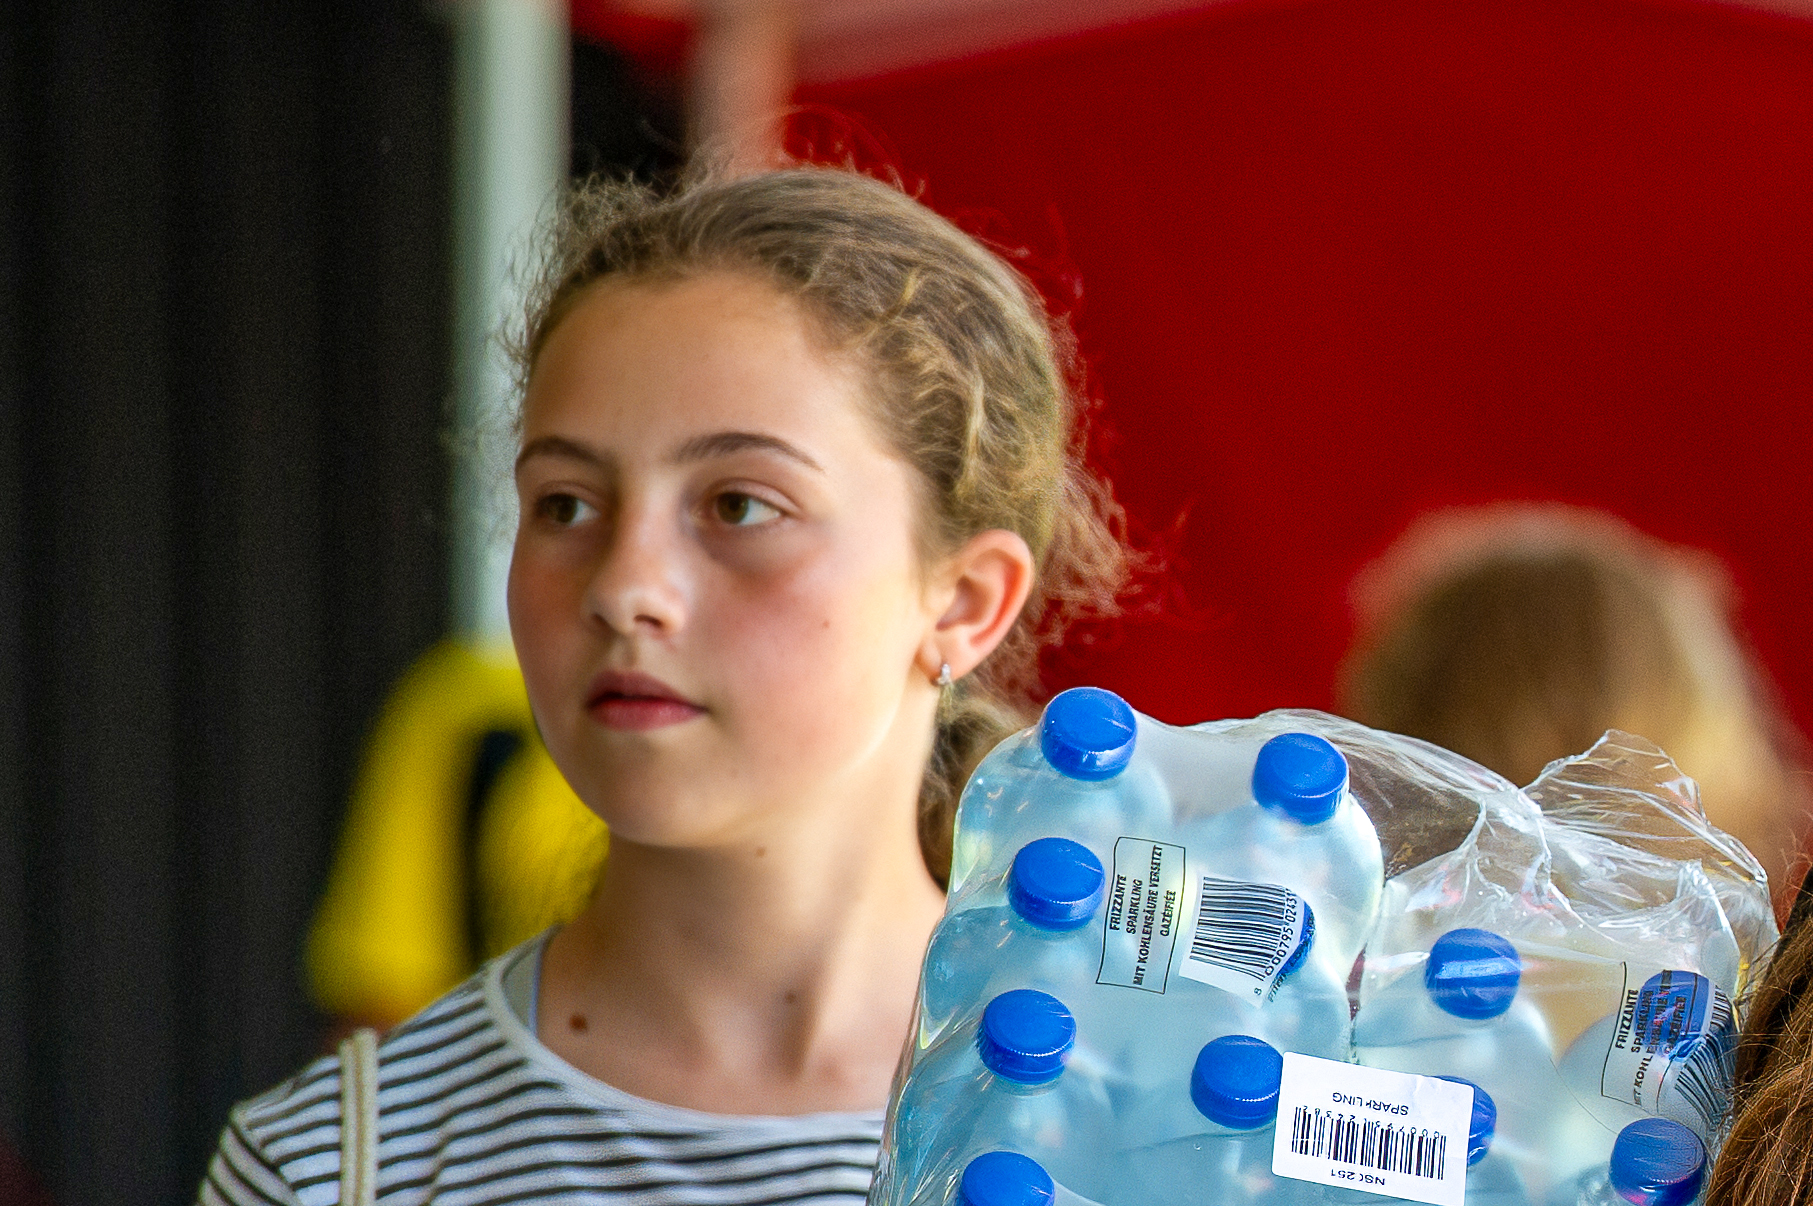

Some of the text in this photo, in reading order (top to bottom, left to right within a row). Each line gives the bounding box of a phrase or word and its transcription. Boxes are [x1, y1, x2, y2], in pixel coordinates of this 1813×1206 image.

[1110, 874, 1127, 931] FRIZZANTE
[1126, 878, 1143, 934] SPARKLING
[1137, 889, 1159, 964] KOHLENSÄURE
[1133, 965, 1146, 986] MIT
[1615, 989, 1638, 1049] FRIZZANTE
[1332, 1091, 1409, 1116] SPARKLING
